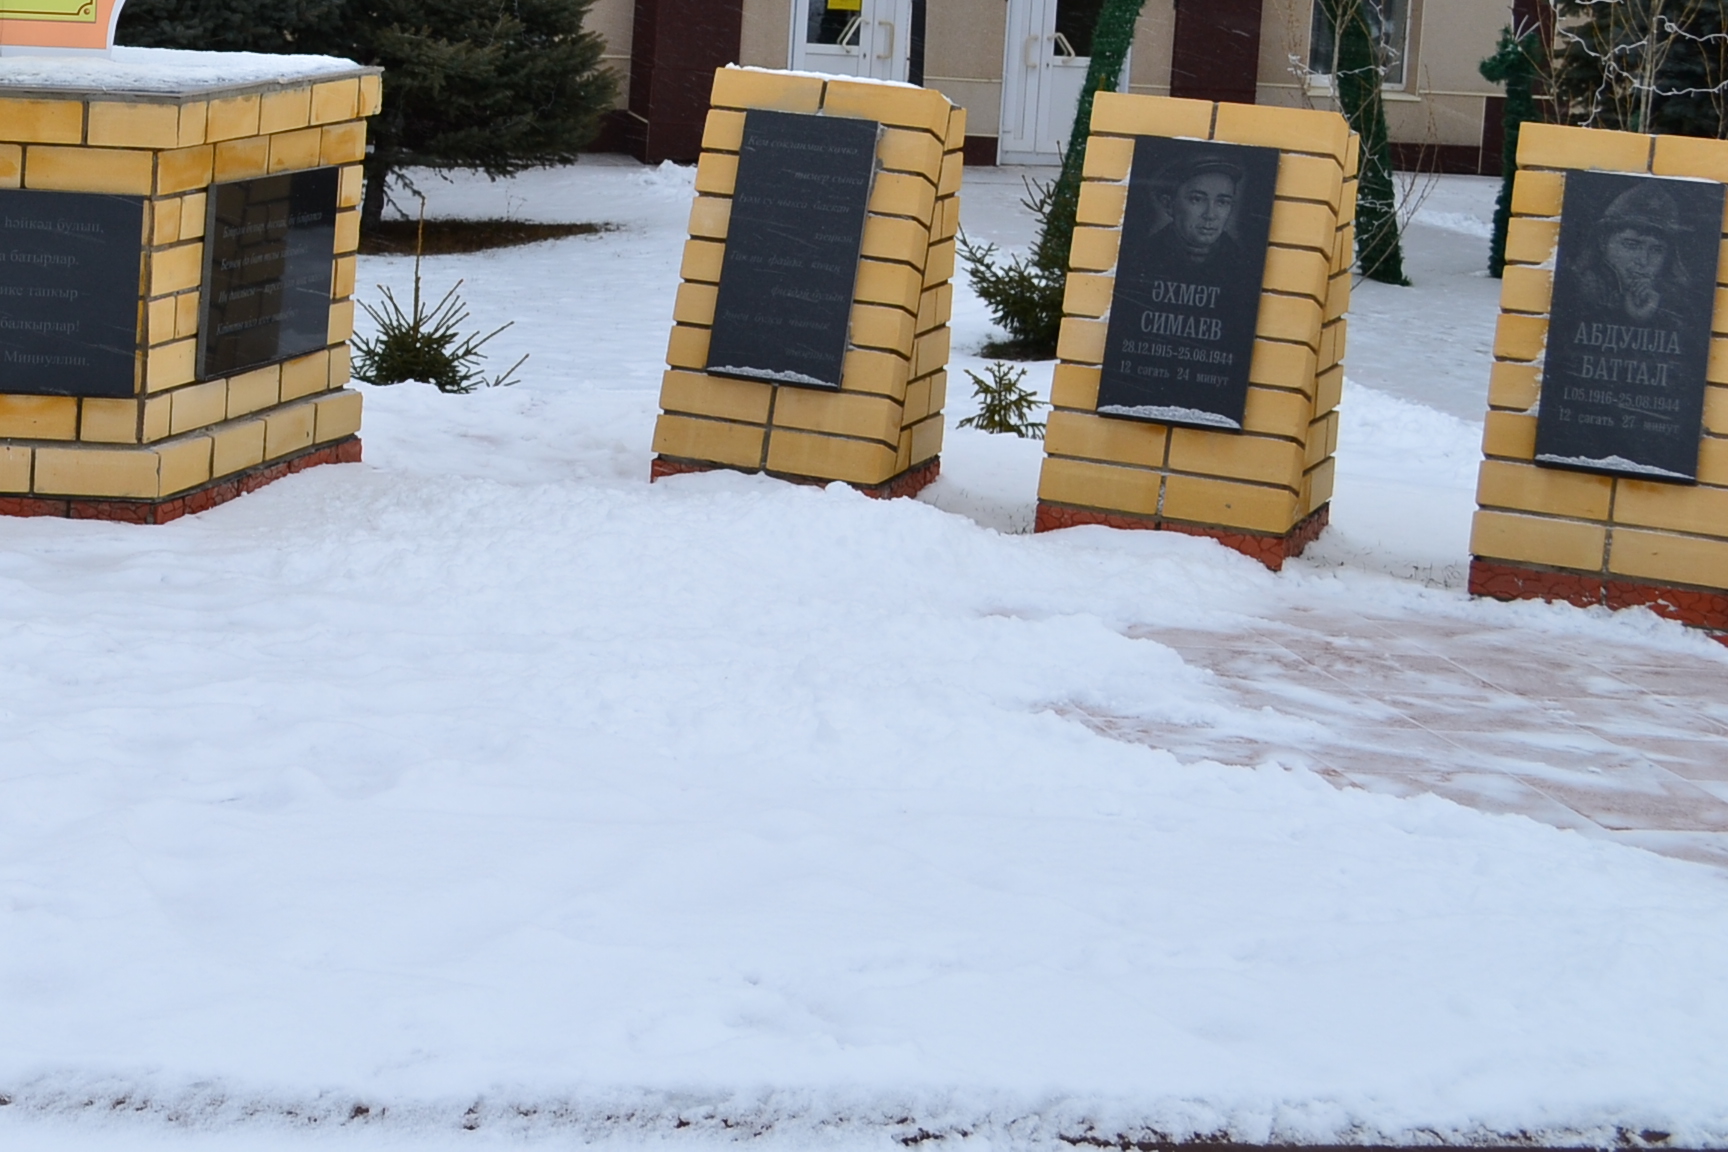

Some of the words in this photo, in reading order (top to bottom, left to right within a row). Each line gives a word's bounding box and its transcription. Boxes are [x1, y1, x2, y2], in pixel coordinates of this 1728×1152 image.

[1152, 281, 1220, 308] ӘХМӘТ
[1141, 310, 1222, 341] СИМАЕВ
[1573, 321, 1682, 354] АБДУЛЛА
[1120, 360, 1132, 374] 12
[1176, 367, 1190, 381] 24
[1196, 373, 1229, 387] минут
[1580, 355, 1668, 387] БАТТАЛ
[1559, 407, 1571, 422] 12
[1621, 415, 1636, 428] 27
